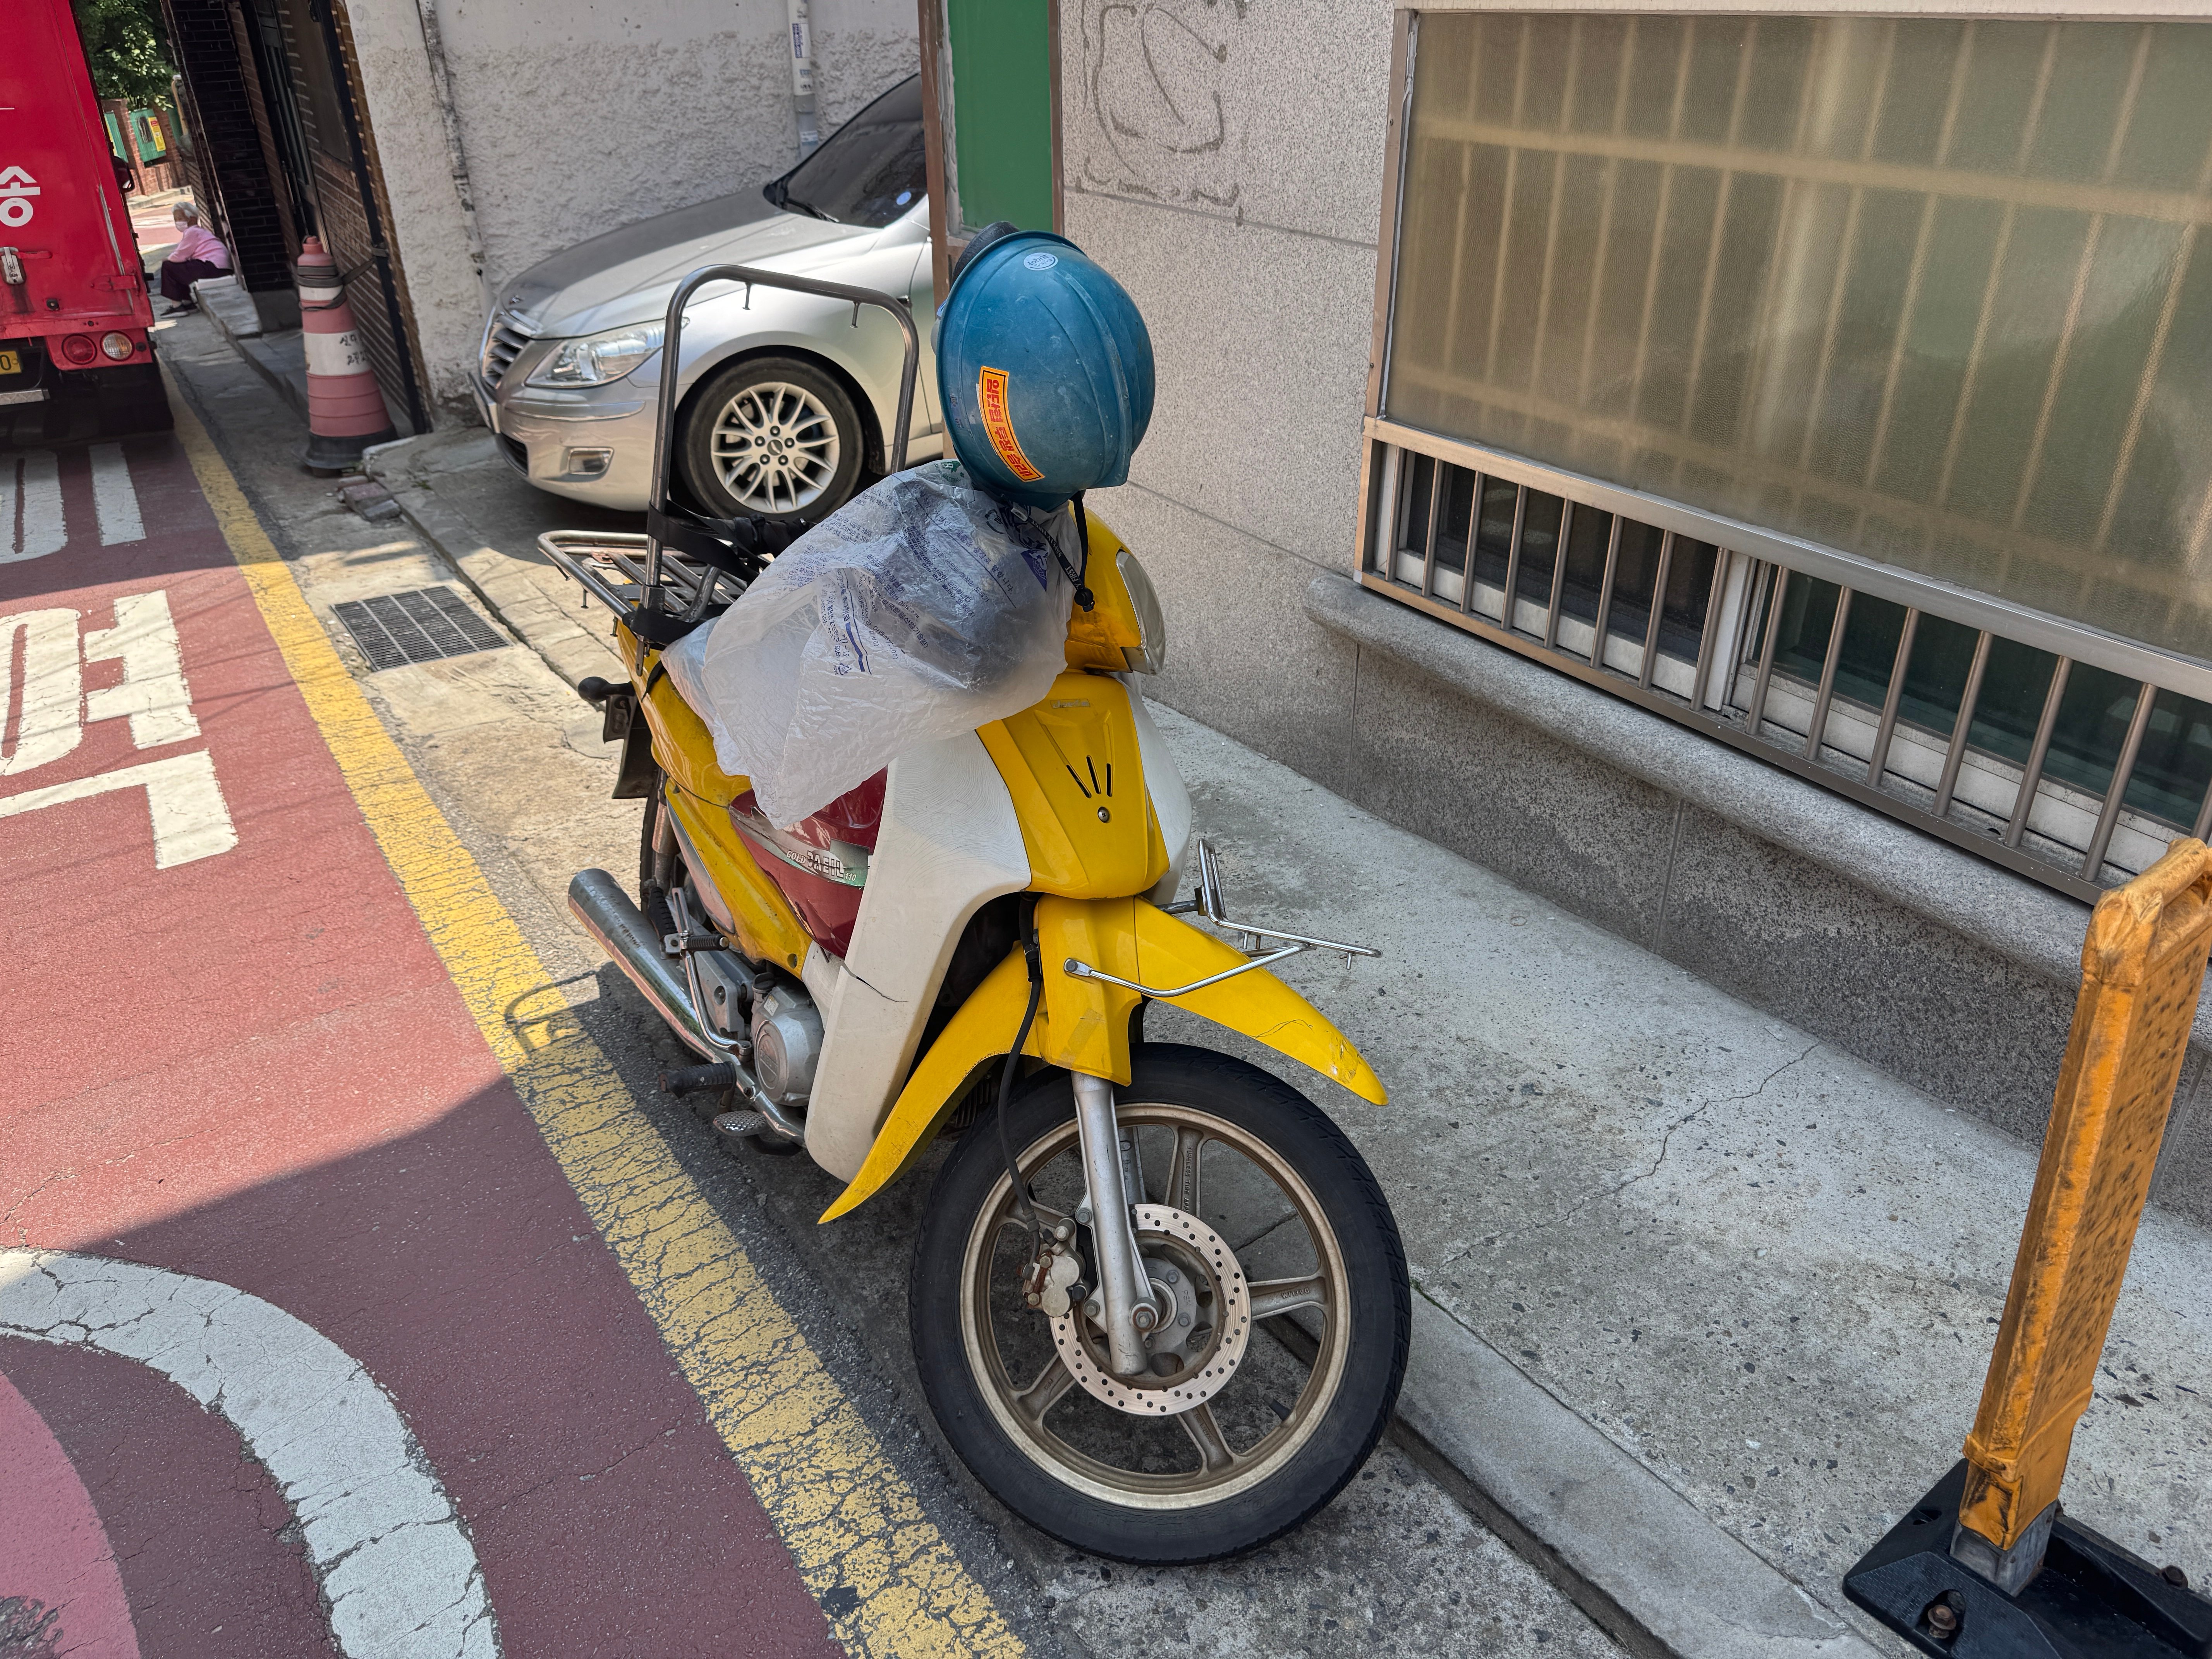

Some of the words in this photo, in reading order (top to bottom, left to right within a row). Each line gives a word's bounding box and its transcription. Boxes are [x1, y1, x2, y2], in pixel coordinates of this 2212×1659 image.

[986, 378, 1003, 422] 임단협
[994, 426, 1015, 451] 투쟁
[1065, 566, 1079, 582] FIRST
[786, 850, 807, 864] GOLD
[845, 872, 857, 881] 110
[1185, 1146, 1193, 1177] TUBELESS
[1182, 1290, 1191, 1306] PSM
[1281, 1288, 1310, 1298] DAELIM
